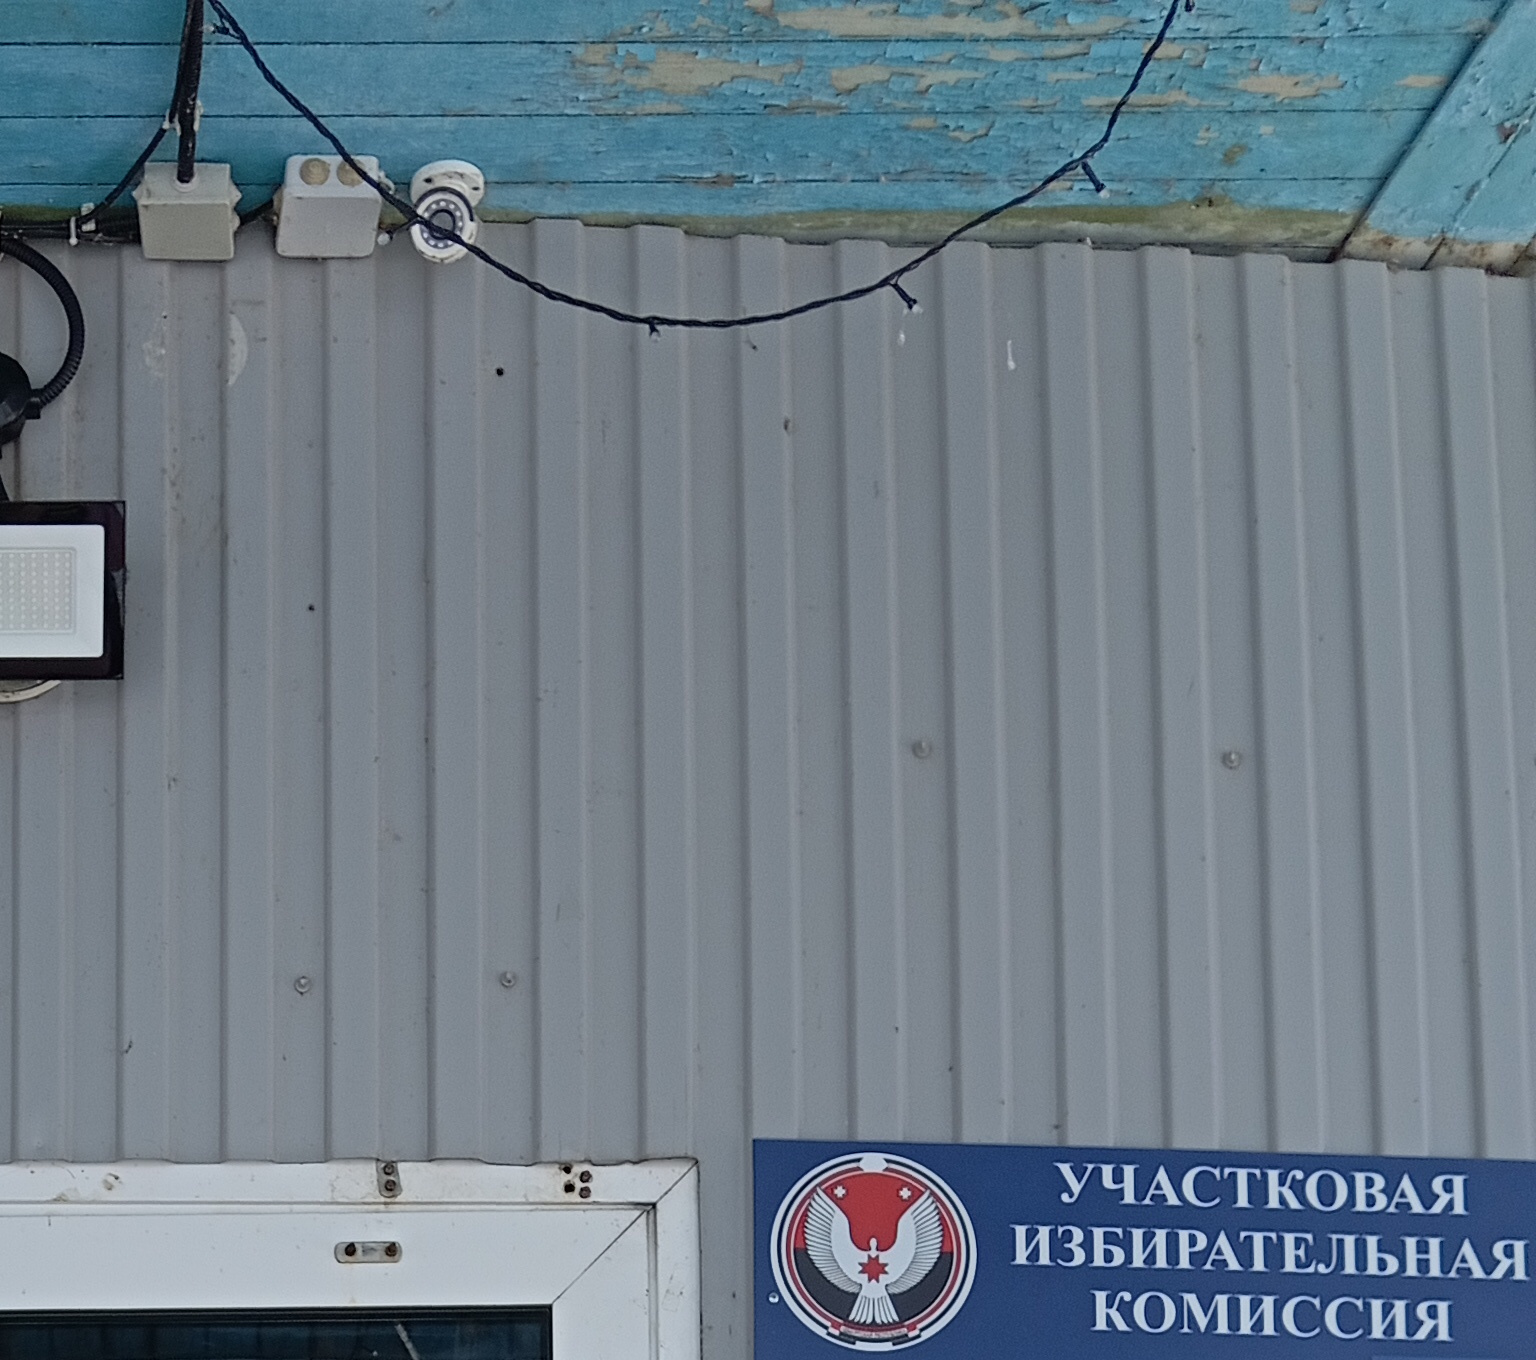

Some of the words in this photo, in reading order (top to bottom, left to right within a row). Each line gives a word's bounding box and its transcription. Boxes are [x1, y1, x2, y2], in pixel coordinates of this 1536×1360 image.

[1054, 1163, 1468, 1214] УЧАСТКОВАЯ
[1010, 1225, 1529, 1280] ИЗБИРАТЕЛЬНАЯ
[1092, 1291, 1452, 1341] КОМИССИЯ
